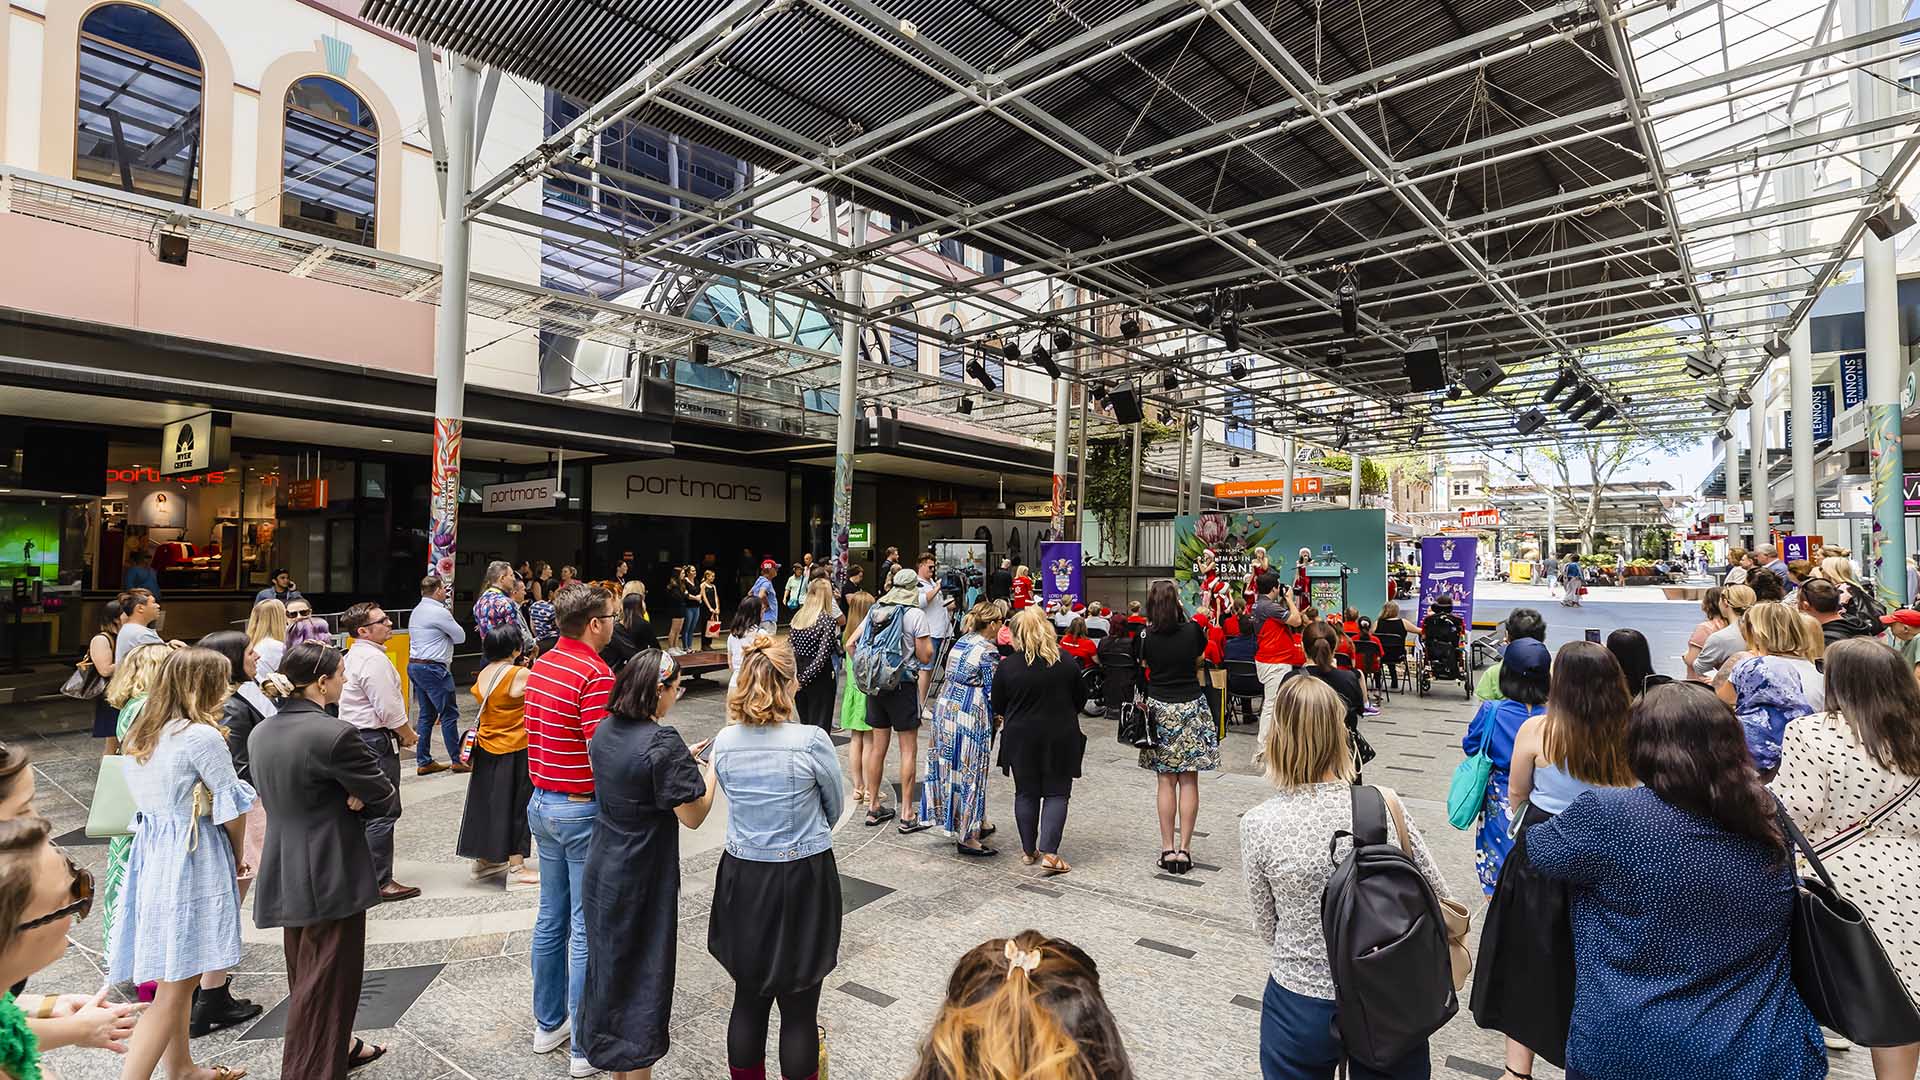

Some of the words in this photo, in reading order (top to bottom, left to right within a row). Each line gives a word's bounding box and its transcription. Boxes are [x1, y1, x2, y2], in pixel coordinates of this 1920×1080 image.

[1844, 359, 1858, 404] ENNONS
[680, 403, 701, 411] QUEEN
[703, 407, 727, 416] STREET
[1812, 390, 1822, 434] LENNONS
[174, 460, 193, 469] CENTRE
[177, 452, 192, 460] MYER
[625, 473, 762, 502] portmans
[490, 486, 548, 507] portmans
[1193, 563, 1253, 573] BSBANE
